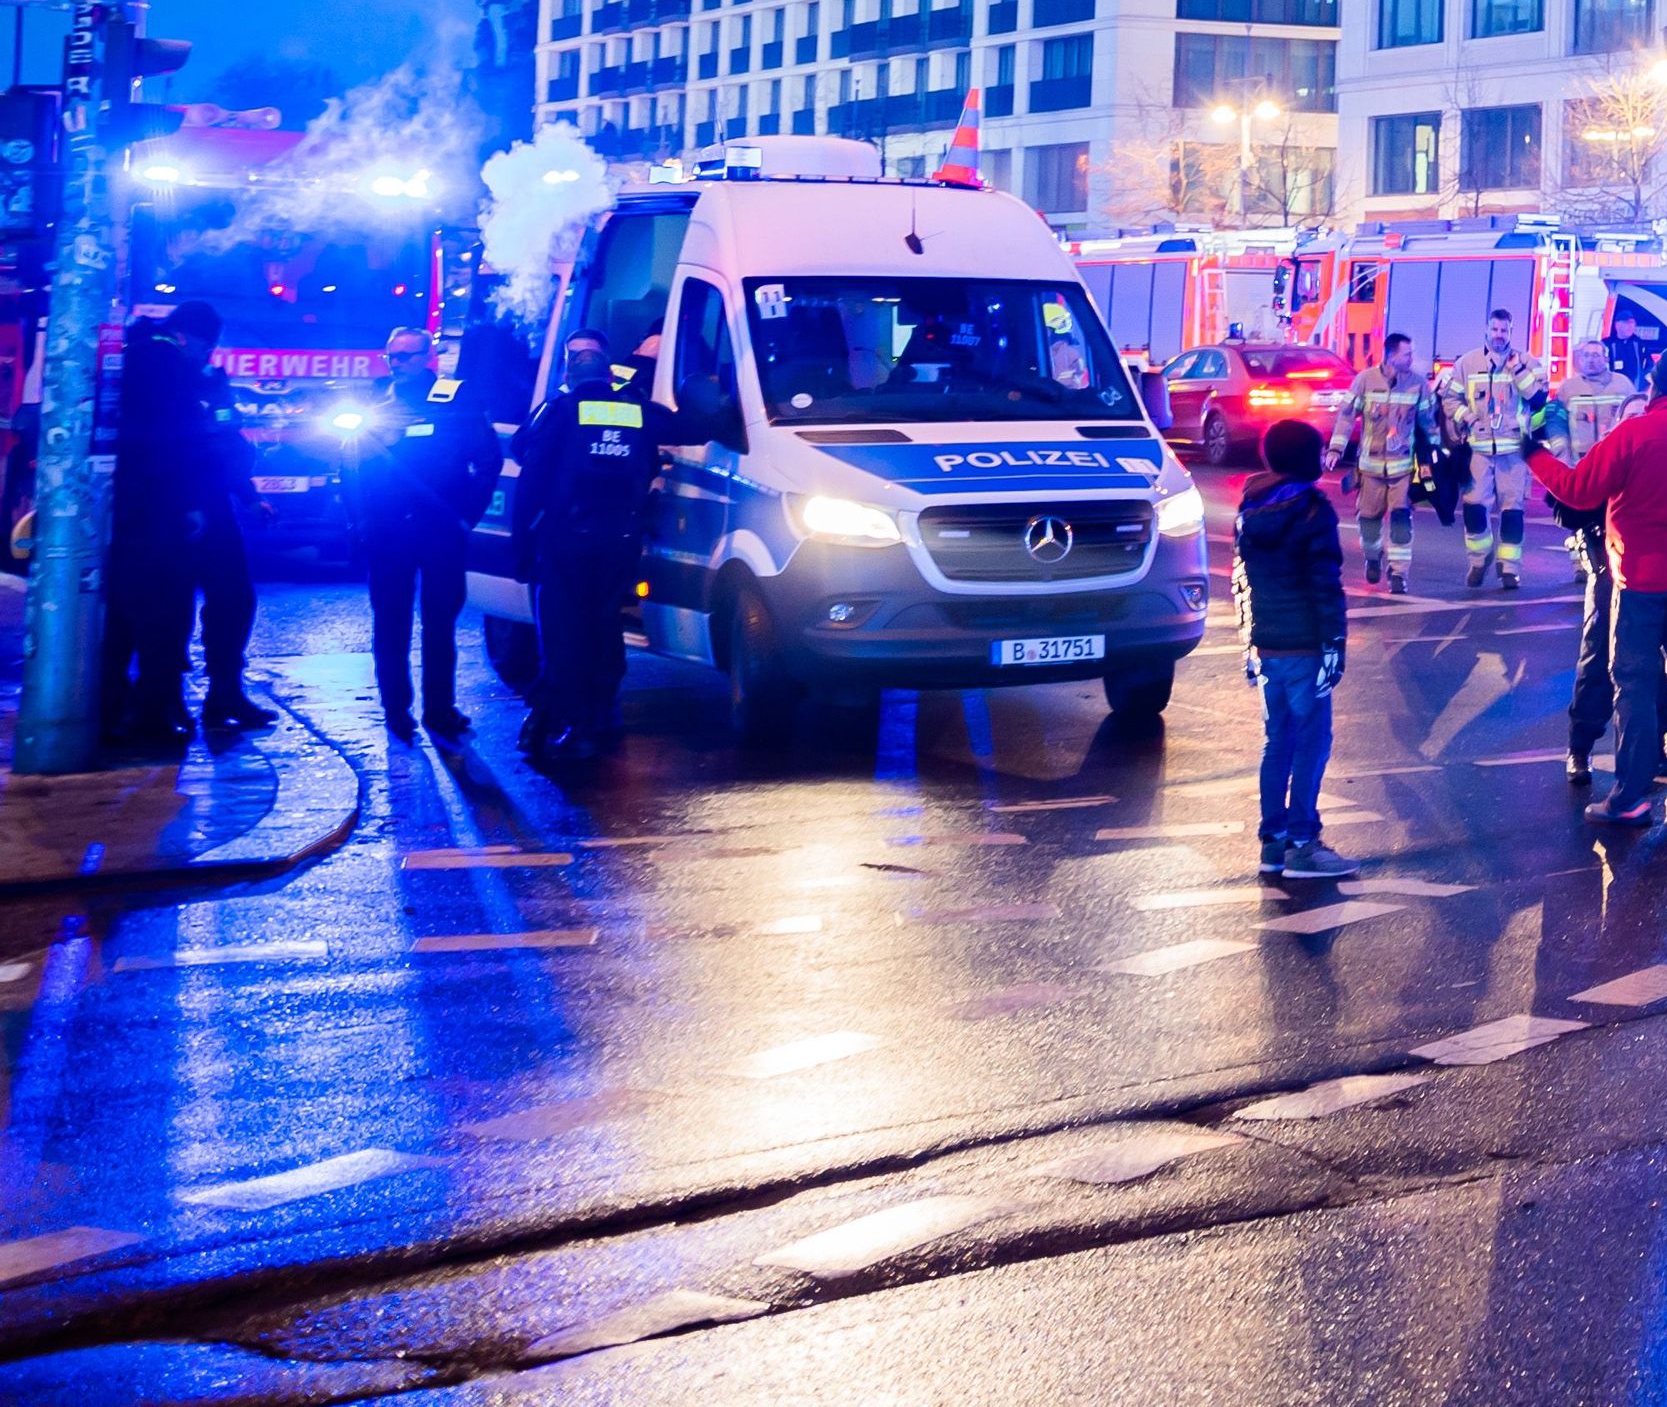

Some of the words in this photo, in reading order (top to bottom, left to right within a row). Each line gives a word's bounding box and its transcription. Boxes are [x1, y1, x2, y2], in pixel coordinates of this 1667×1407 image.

[602, 430, 622, 443] BE
[933, 450, 1111, 472] POLIZEI
[1013, 643, 1025, 661] B
[1039, 639, 1095, 659] 31751
